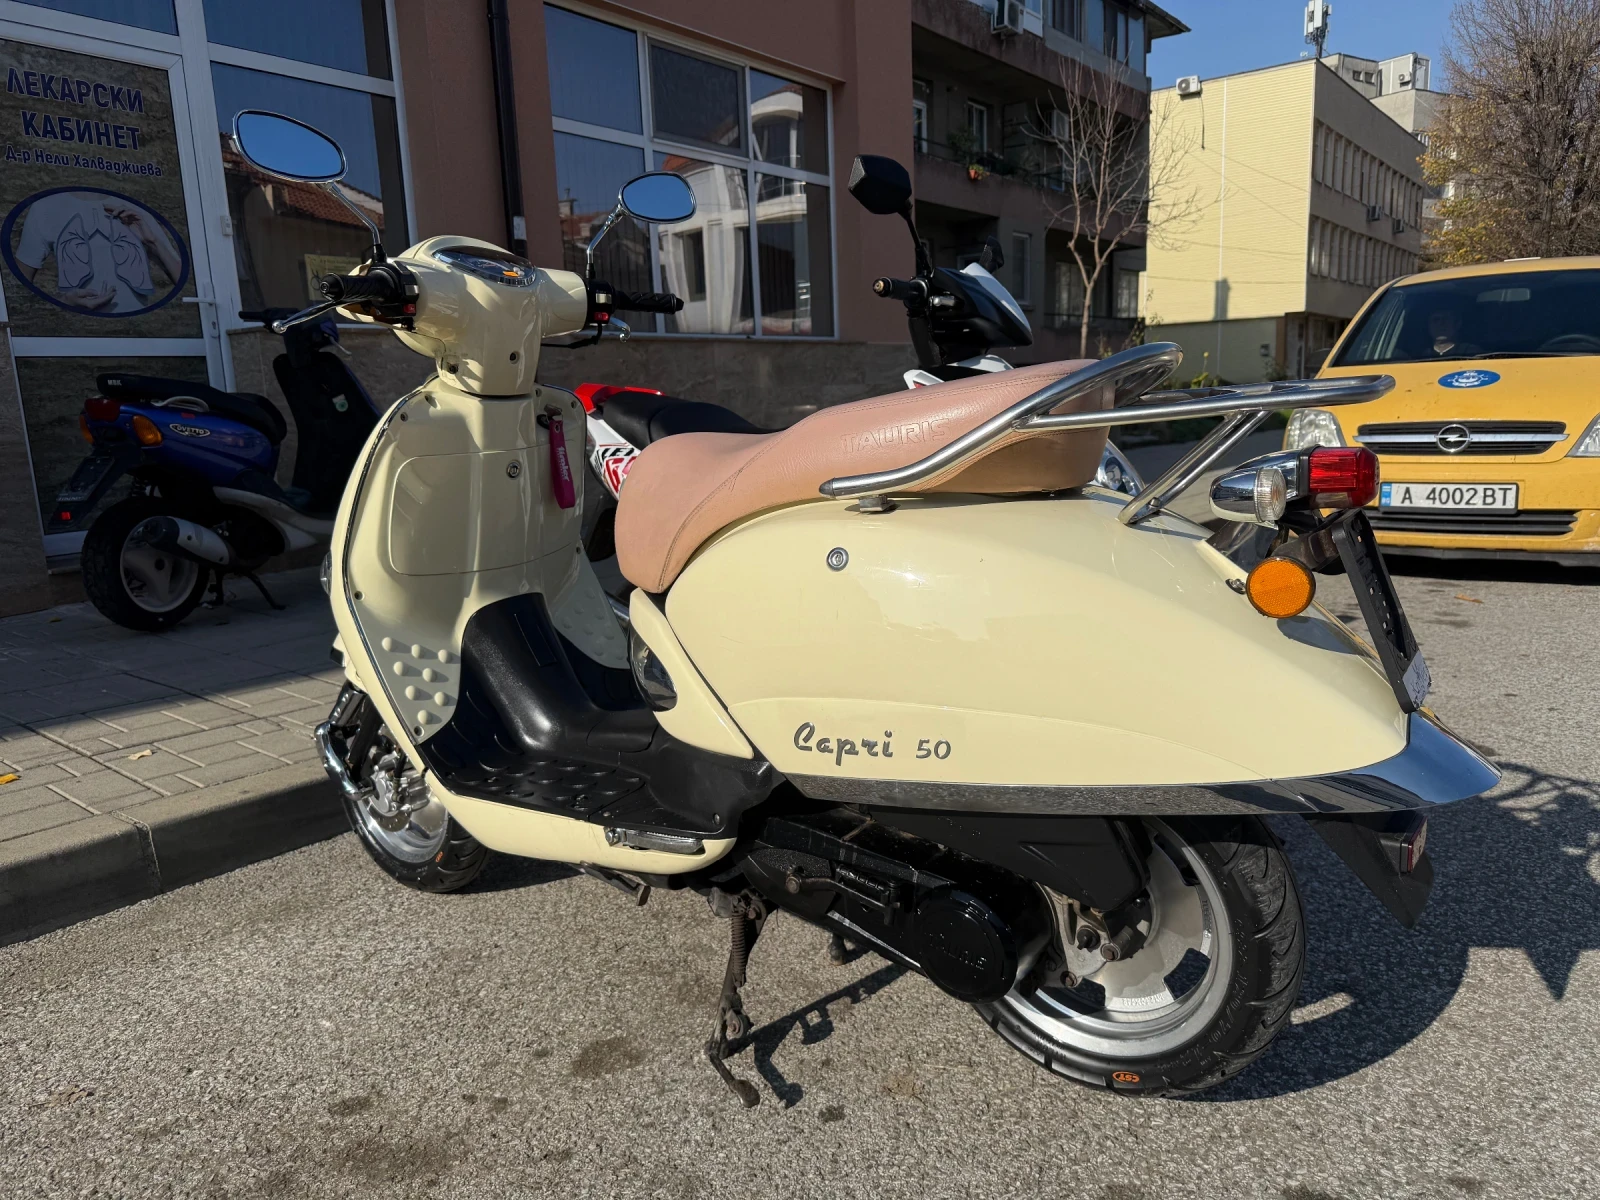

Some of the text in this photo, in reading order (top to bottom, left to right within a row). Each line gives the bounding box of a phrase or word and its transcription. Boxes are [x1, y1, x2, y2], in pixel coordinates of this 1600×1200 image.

[7, 68, 143, 113] ЛЕКАРСКИ
[21, 111, 140, 150] КАБИНЕТ
[5, 145, 163, 178] Д-р Нели Халваджиева
[840, 418, 951, 452] TAURIS
[1401, 486, 1413, 504] A
[793, 721, 952, 767] Capri 50
